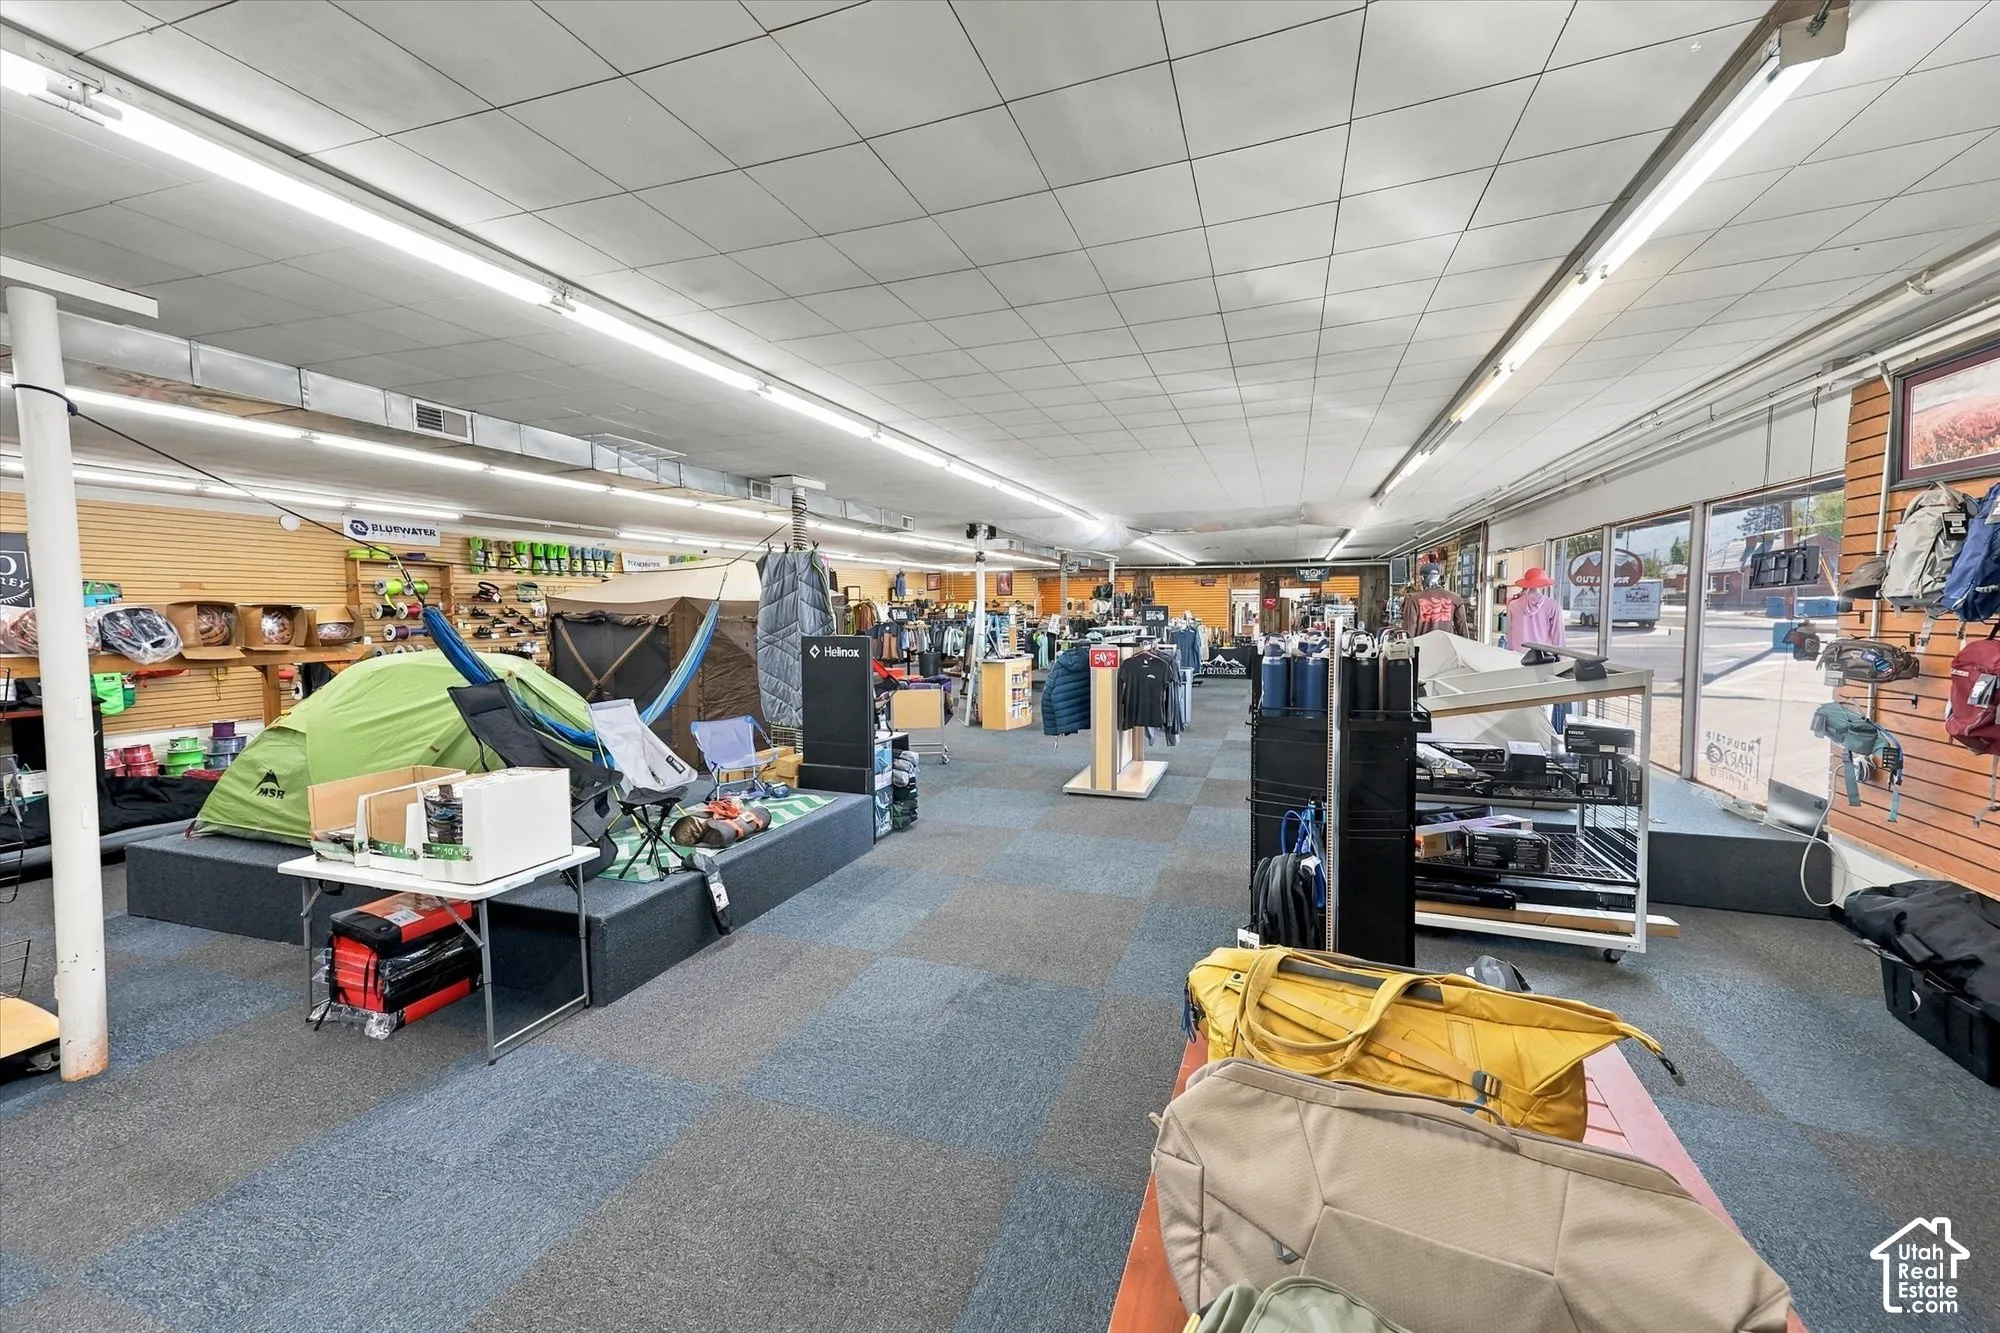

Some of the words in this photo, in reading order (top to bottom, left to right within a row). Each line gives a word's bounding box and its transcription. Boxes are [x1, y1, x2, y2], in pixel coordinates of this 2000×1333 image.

[371, 523, 436, 537] BLUEWATER
[824, 645, 860, 658] Helinox
[256, 787, 286, 799] MSR
